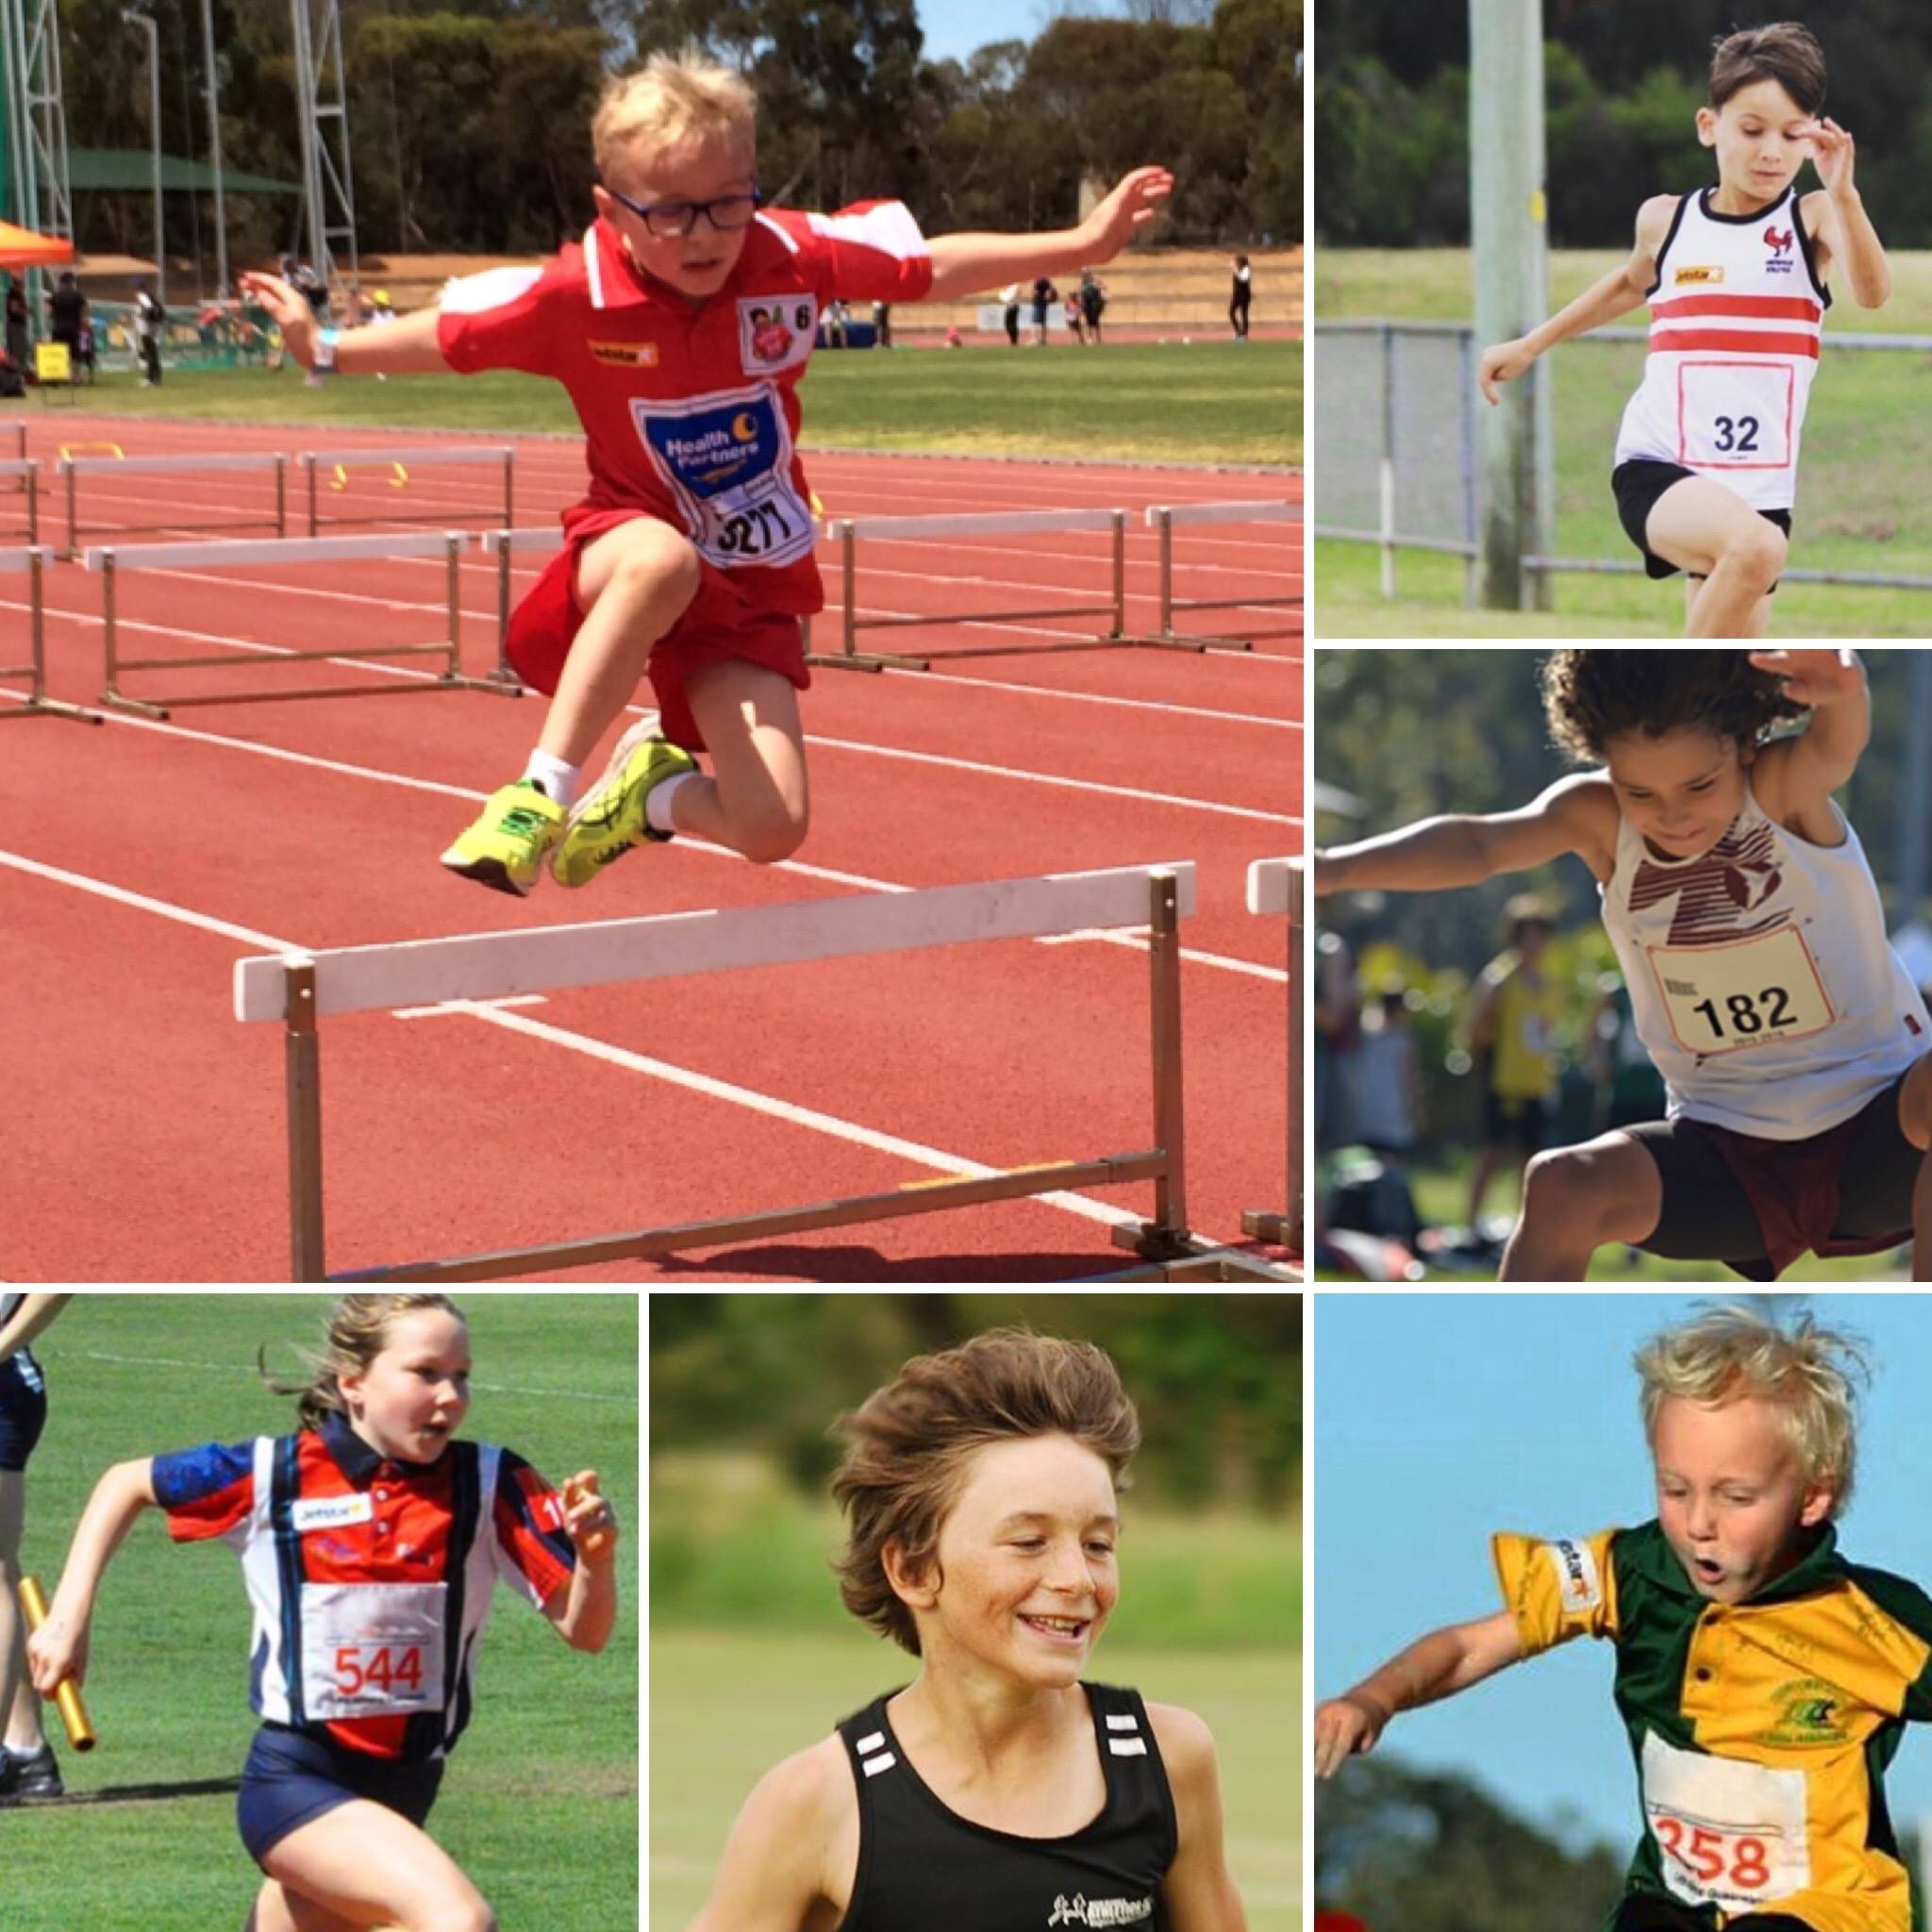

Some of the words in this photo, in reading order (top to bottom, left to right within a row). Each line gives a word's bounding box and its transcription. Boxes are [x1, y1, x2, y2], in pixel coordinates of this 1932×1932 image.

[795, 304, 810, 330] 6
[665, 429, 730, 458] Health
[1714, 415, 1759, 452] 32
[677, 441, 759, 469] Partners
[1692, 986, 1798, 1039] 182
[335, 1644, 423, 1697] 544
